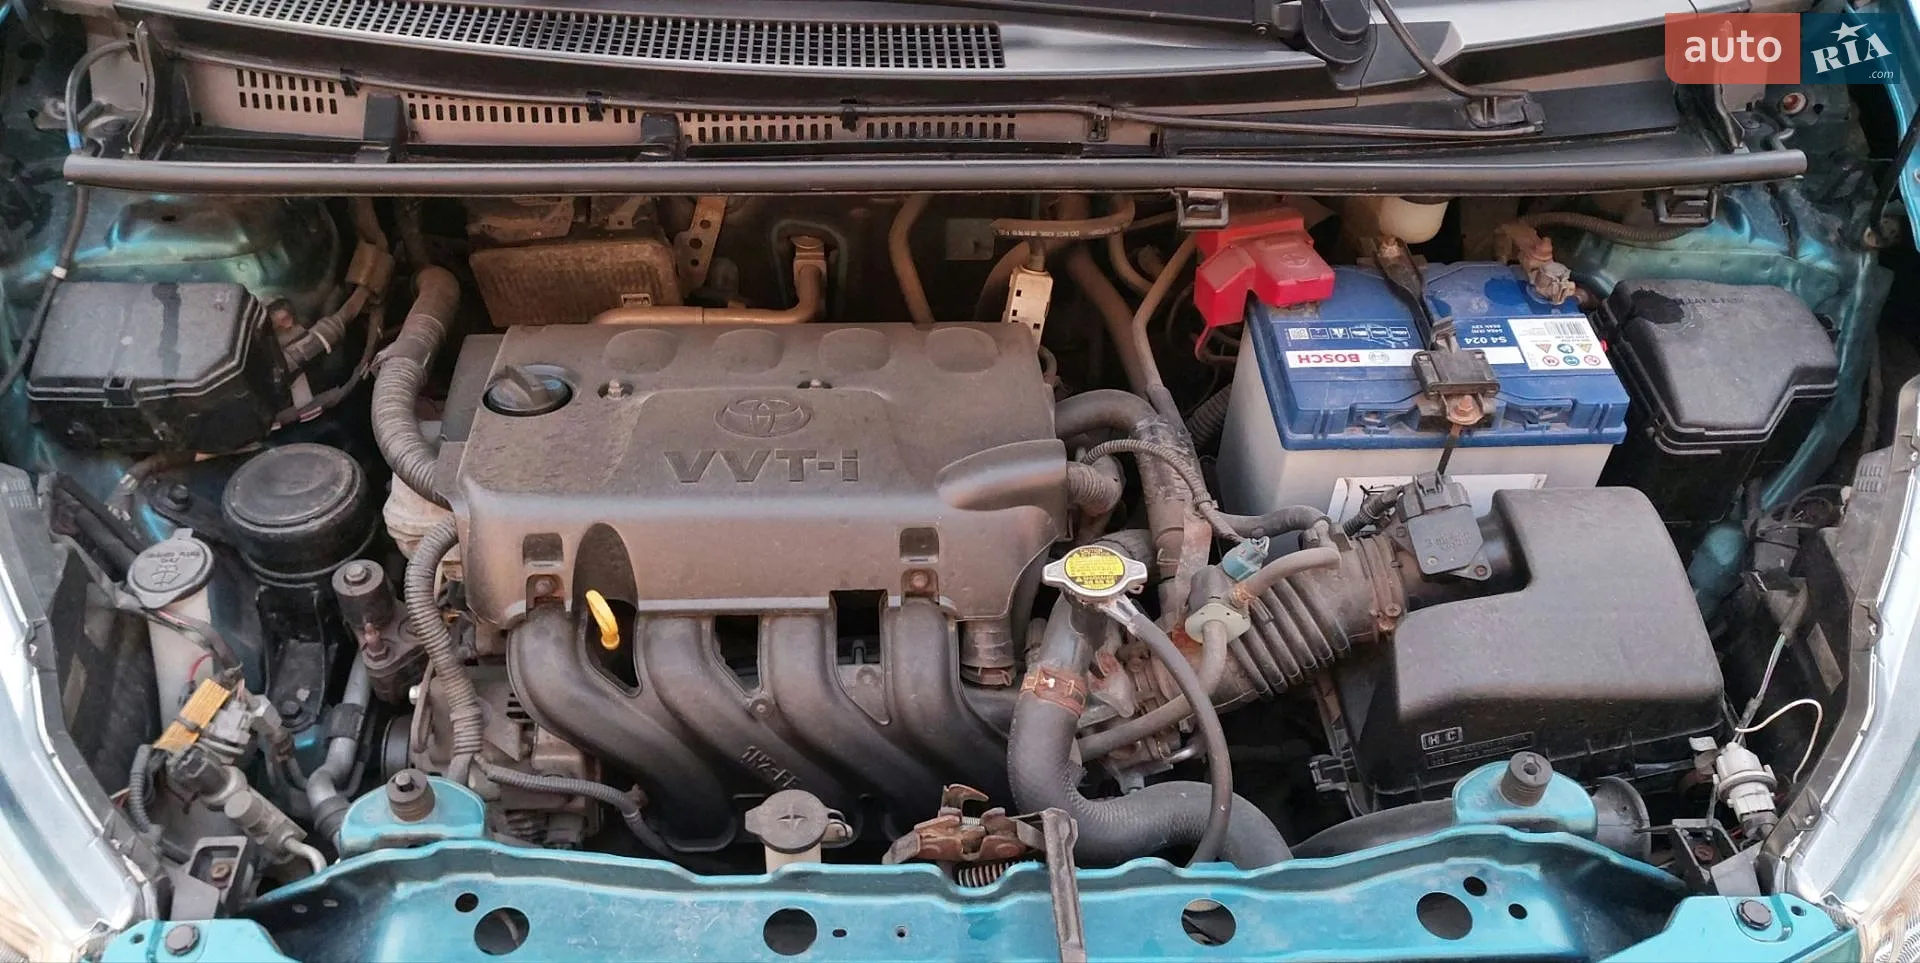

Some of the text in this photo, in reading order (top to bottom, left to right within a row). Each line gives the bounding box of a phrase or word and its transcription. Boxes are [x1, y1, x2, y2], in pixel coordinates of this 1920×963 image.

[1464, 336, 1508, 345] S4 024
[1297, 353, 1360, 364] BOSCH
[664, 448, 861, 484] VVT-i
[1427, 730, 1457, 746] H C
